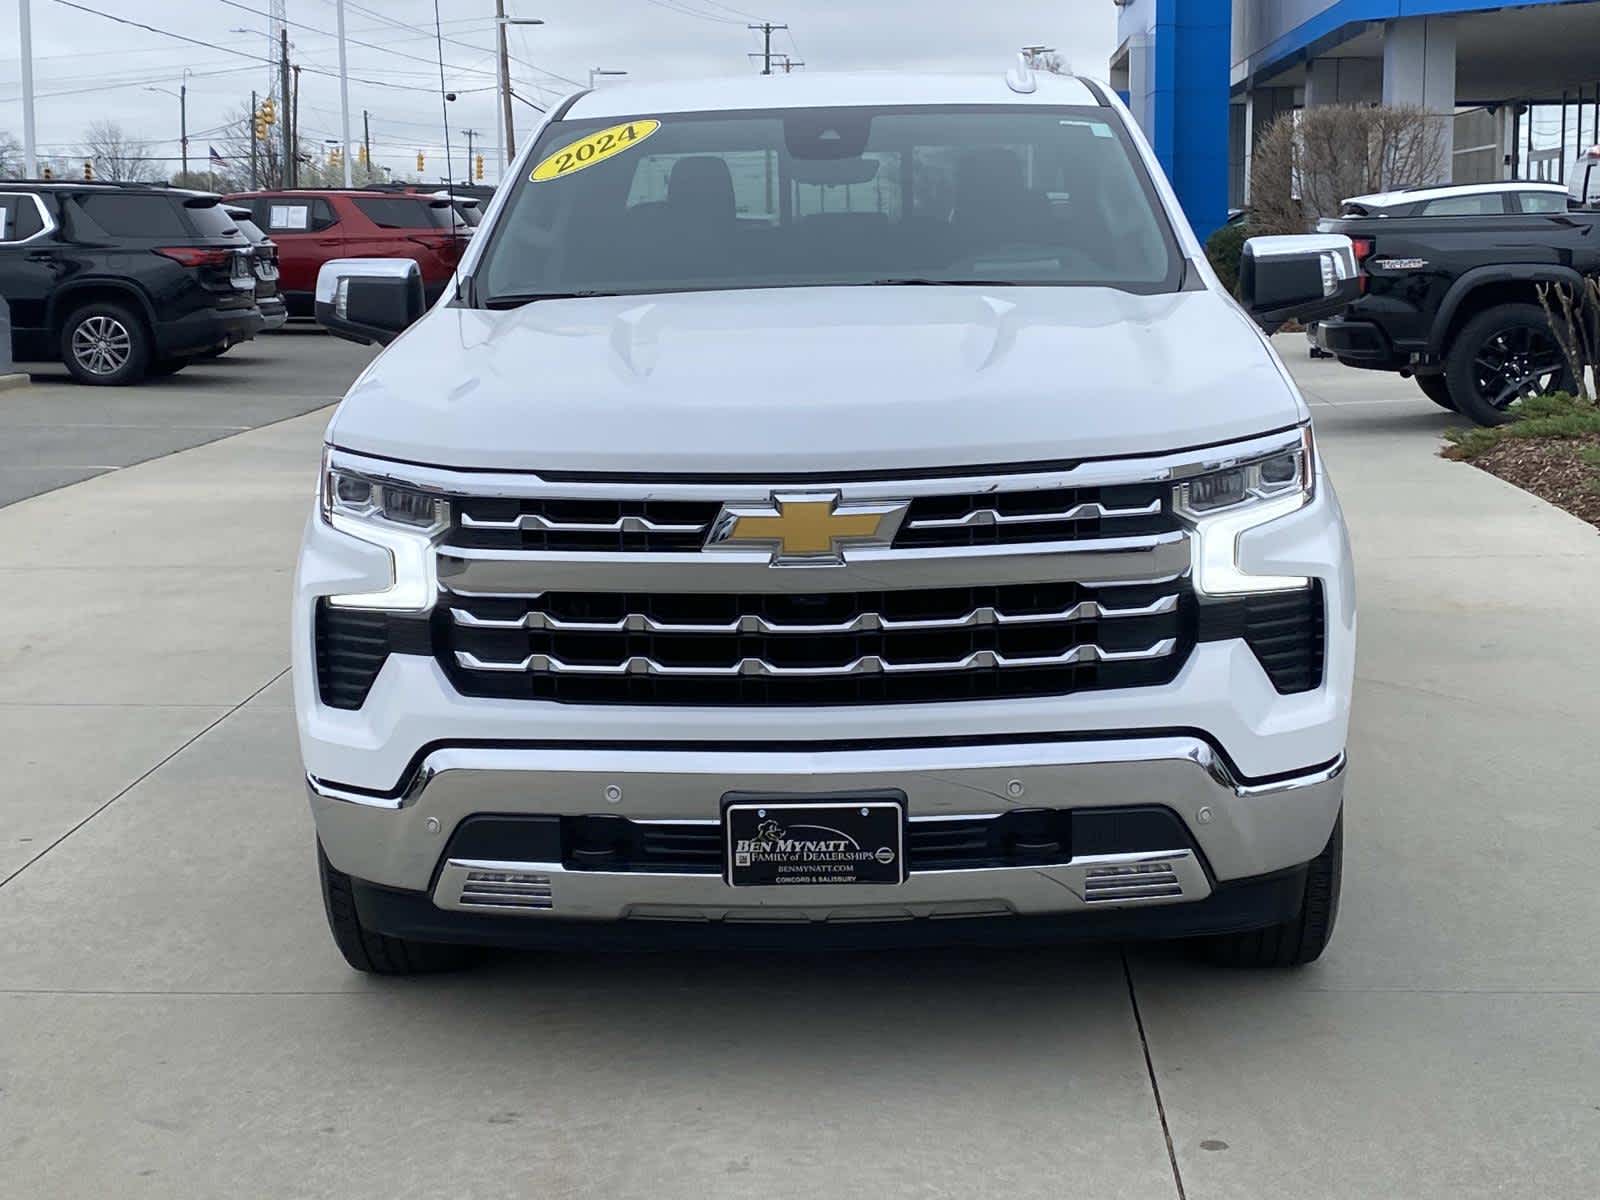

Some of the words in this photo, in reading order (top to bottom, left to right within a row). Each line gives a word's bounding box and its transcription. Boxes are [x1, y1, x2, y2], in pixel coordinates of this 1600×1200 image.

[555, 125, 639, 173] 2024
[736, 839, 775, 852] BEN
[776, 839, 849, 852] MYNATT
[751, 852, 789, 862] FAMILY
[803, 851, 874, 861] DEALERSHIPS
[778, 864, 854, 873] BENMYNATT.COM
